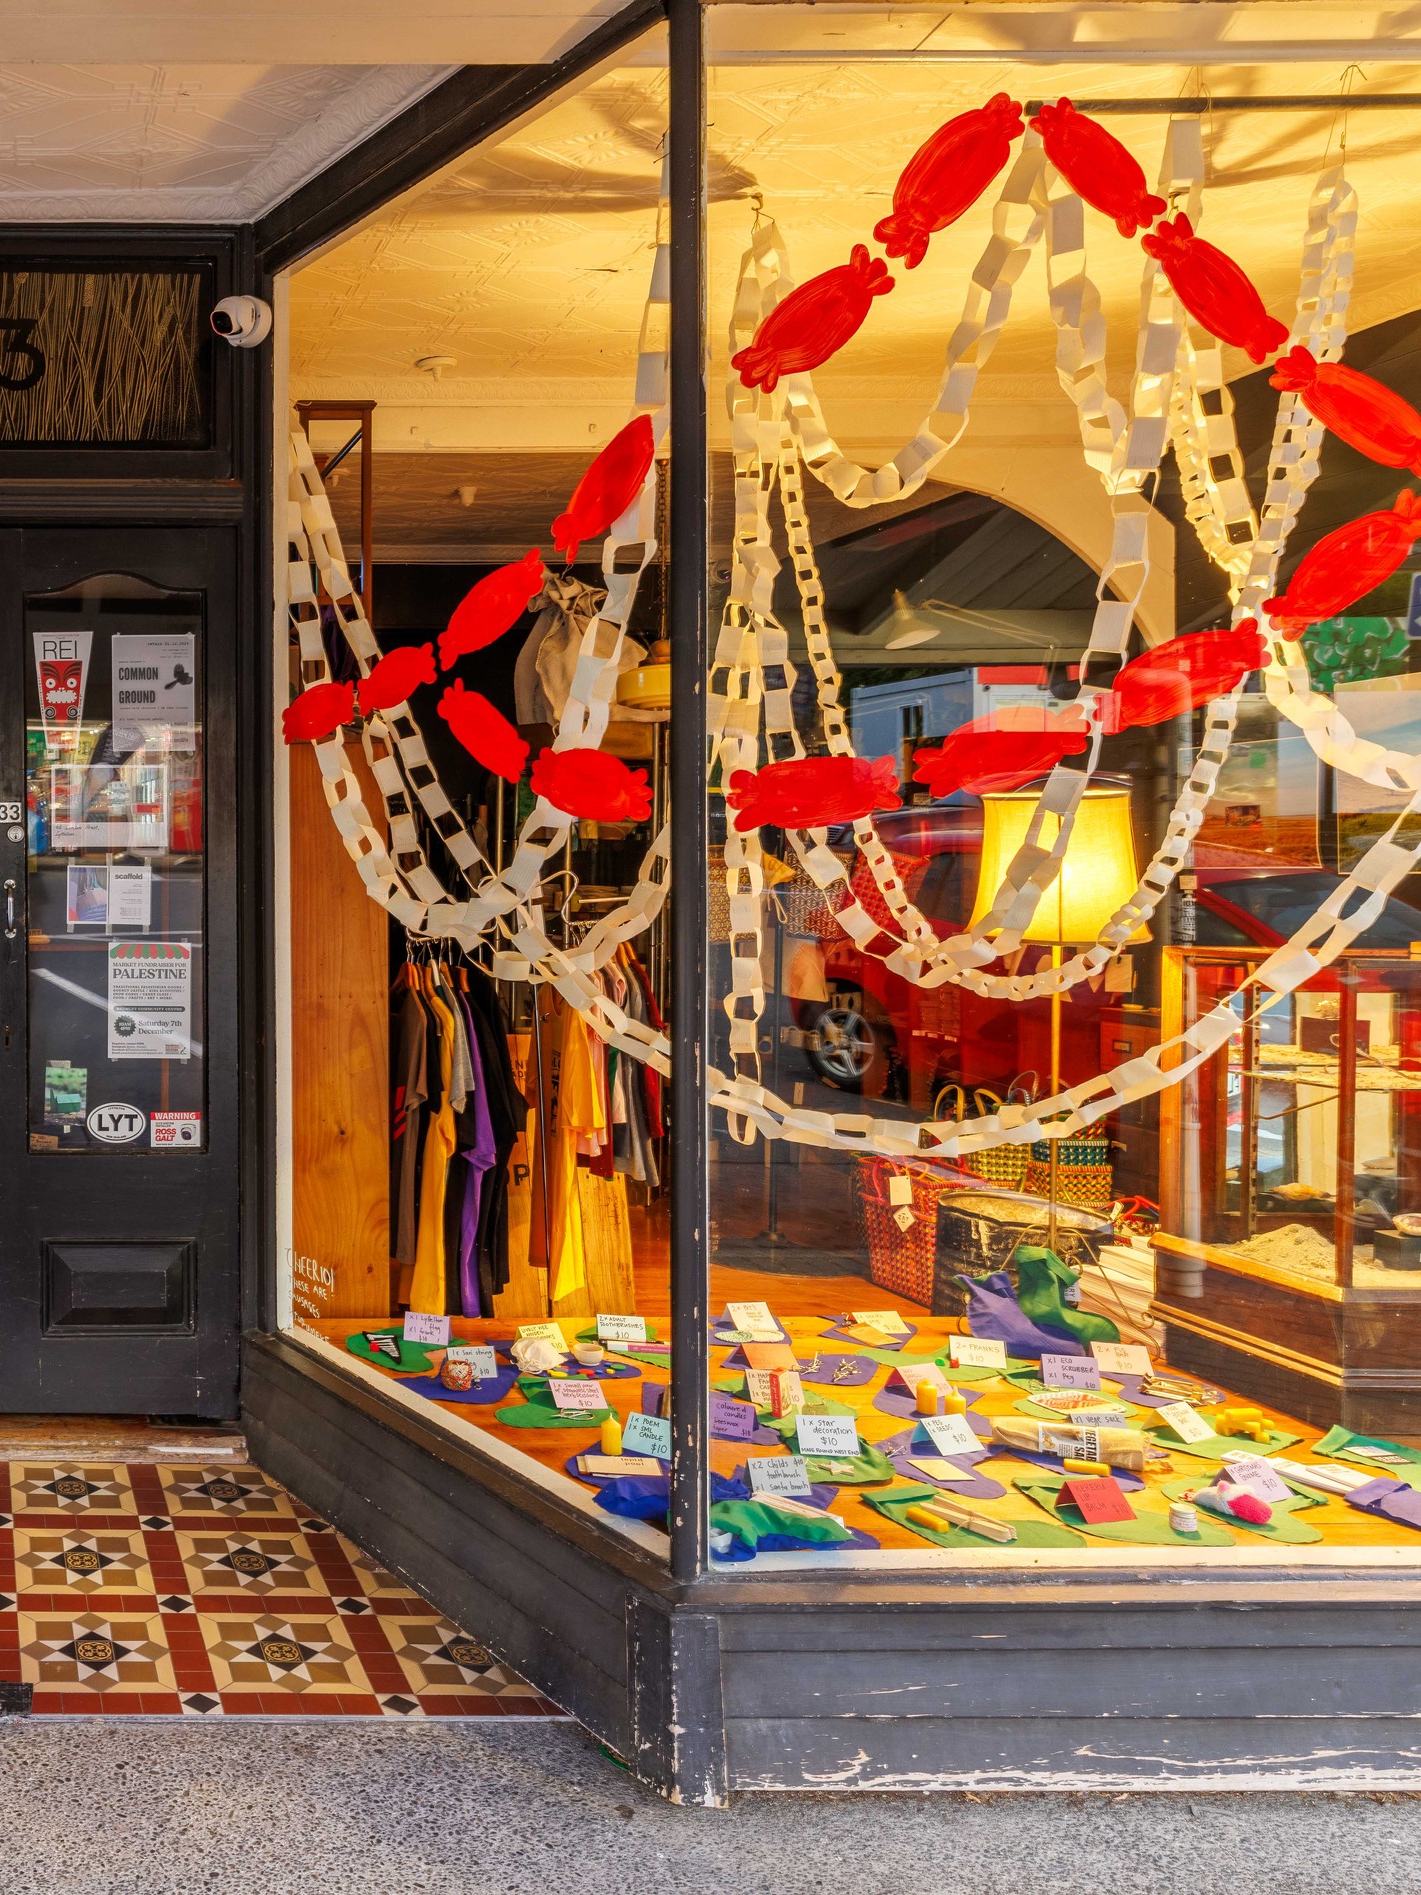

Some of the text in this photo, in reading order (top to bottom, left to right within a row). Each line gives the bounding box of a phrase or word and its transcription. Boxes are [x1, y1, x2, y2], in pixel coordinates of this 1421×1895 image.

[43, 640, 77, 659] REI
[119, 667, 159, 680] COMMON
[119, 690, 156, 703] GROUND
[113, 969, 187, 979] PALESTINE
[155, 1112, 196, 1120] WARNING
[97, 1114, 138, 1132] LYT
[313, 1285, 328, 1300] ARE
[599, 1321, 644, 1330] TOOTHBRUSHES
[615, 1331, 629, 1340] $10
[969, 1343, 1000, 1353] FRANKS
[968, 1354, 984, 1363] $10
[480, 1368, 489, 1376] $10
[1061, 1365, 1094, 1374] SCRUBBER
[642, 1418, 660, 1427] POEM
[812, 1426, 853, 1435] decoration
[936, 1424, 953, 1434] SEEDS
[639, 1431, 663, 1442] CANDLE
[820, 1436, 838, 1446] $10
[952, 1433, 967, 1445] $10
[650, 1443, 668, 1454] $10
[1085, 1430, 1097, 1462] EGETAB
[793, 1457, 804, 1466] $10
[1261, 1478, 1278, 1492] $10
[1085, 1503, 1106, 1512] BALM
[1112, 1503, 1130, 1515] $10
